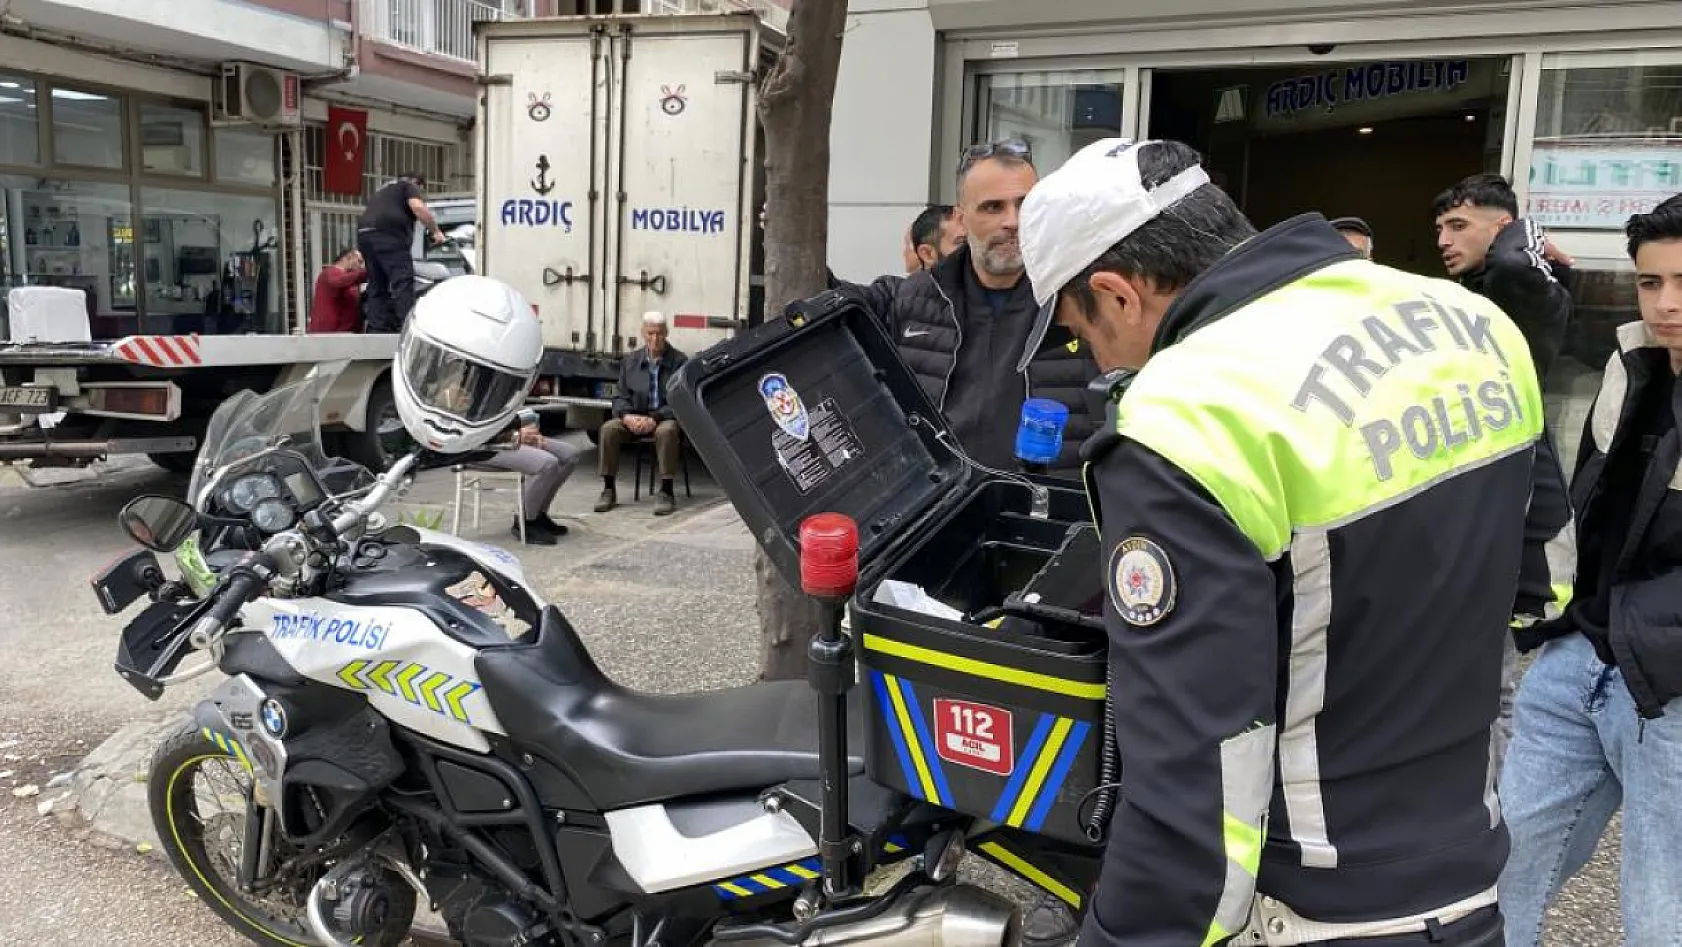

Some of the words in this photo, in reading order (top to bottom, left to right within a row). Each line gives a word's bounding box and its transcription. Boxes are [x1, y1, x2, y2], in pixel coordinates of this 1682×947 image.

[502, 199, 573, 233] ARDIÇ
[632, 206, 725, 234] MOBİLYA
[1290, 292, 1509, 428] TRAFİK
[1359, 370, 1524, 482] POLİSİ
[272, 611, 327, 640] TRAFİK
[322, 617, 394, 651] POLİSİ
[949, 705, 994, 740] 112
